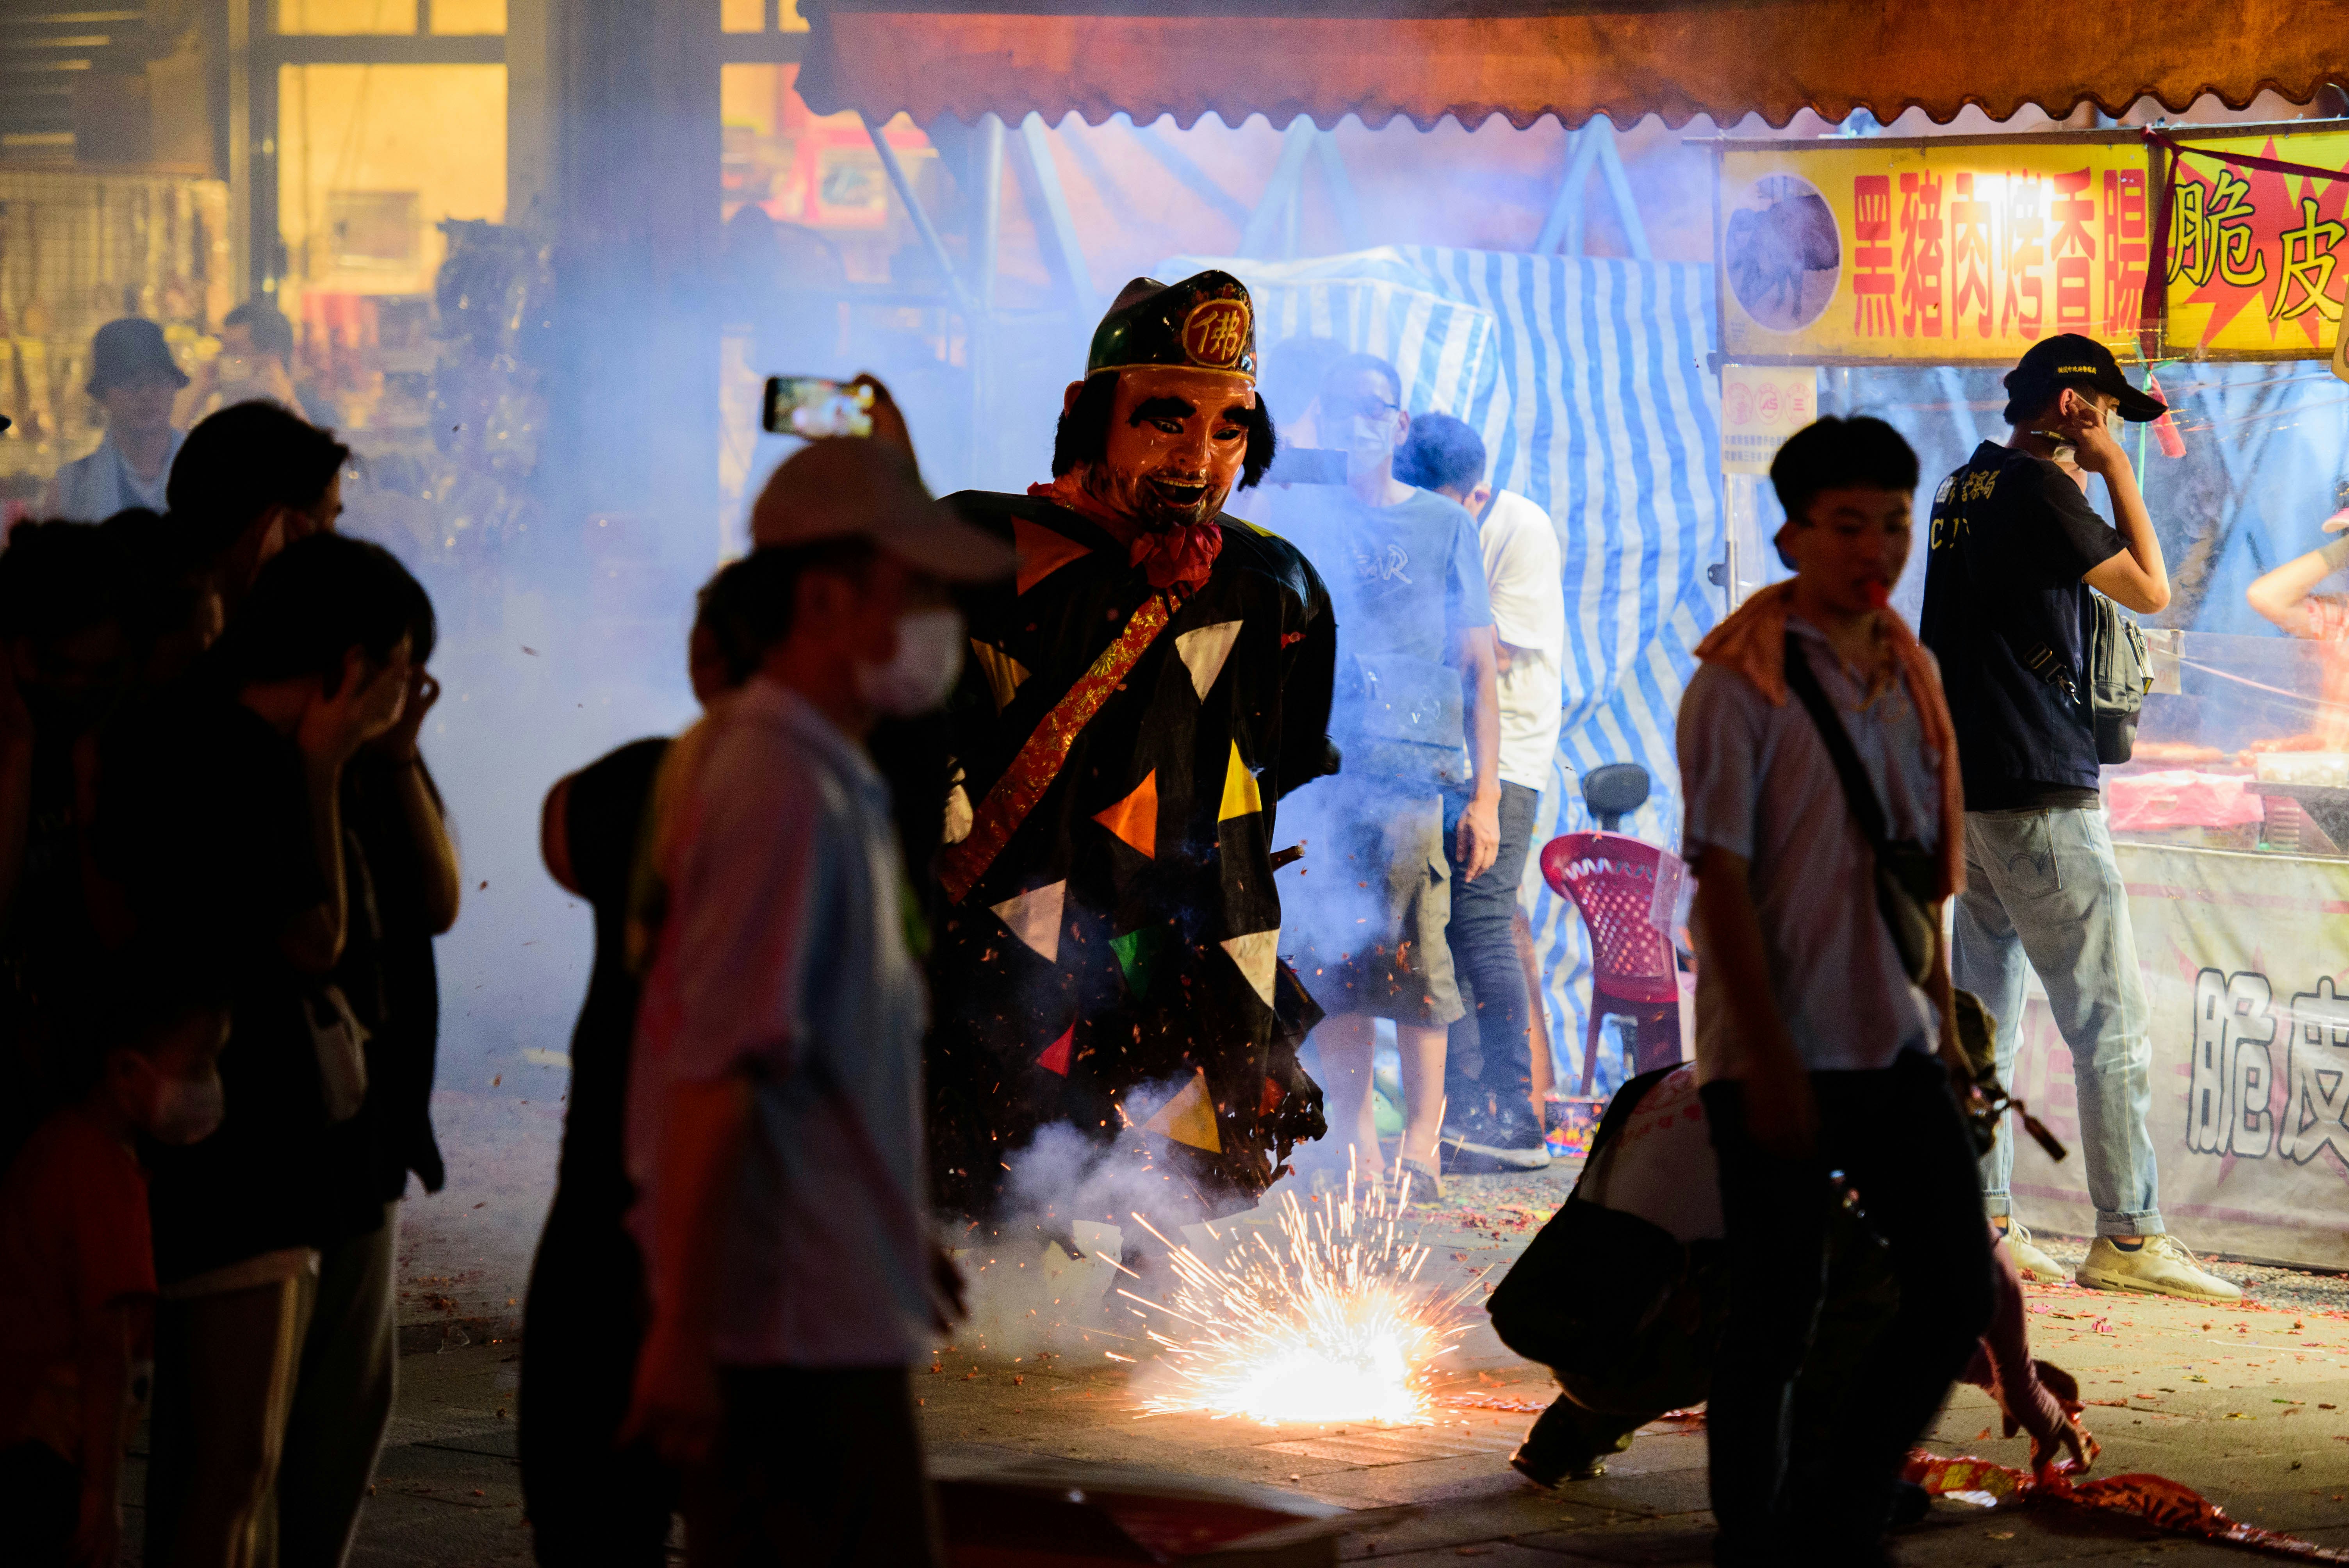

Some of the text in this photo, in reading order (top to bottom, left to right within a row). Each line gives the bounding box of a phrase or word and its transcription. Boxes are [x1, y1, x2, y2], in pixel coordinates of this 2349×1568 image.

[1854, 167, 2147, 341] 黑豬肉烤香腸
[2167, 169, 2347, 323] 脆皮
[2187, 967, 2349, 1166] 脆皮
